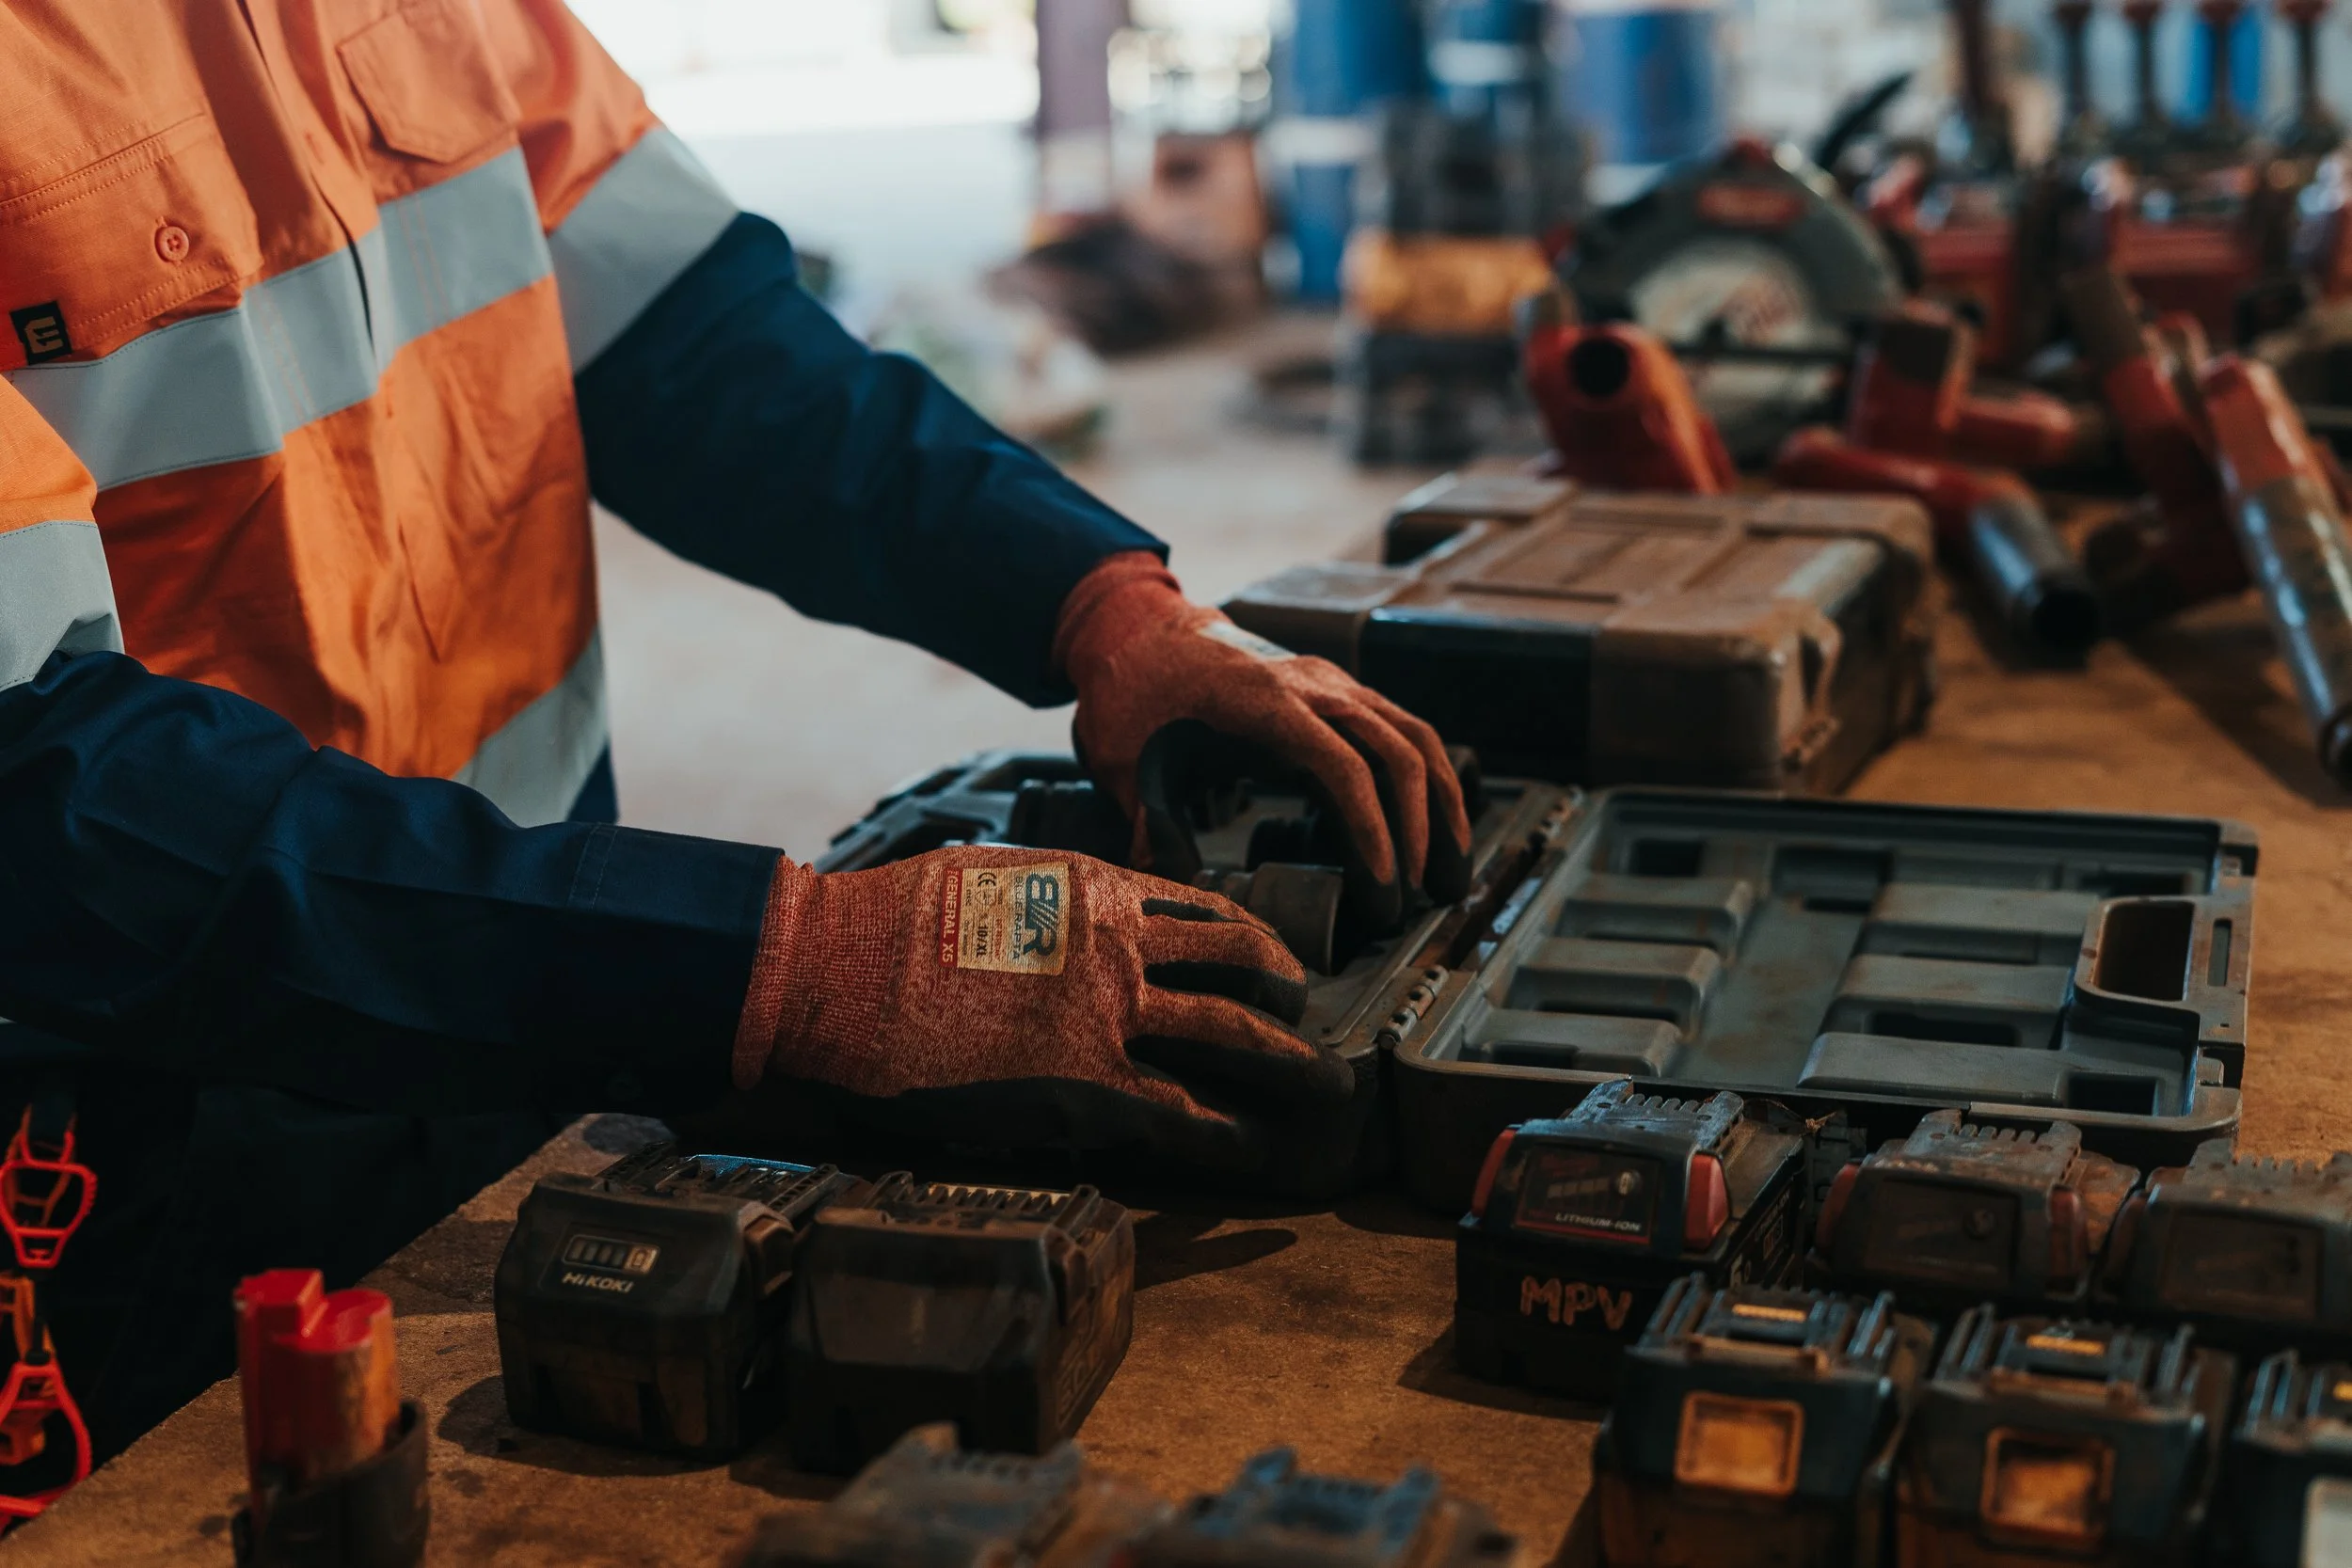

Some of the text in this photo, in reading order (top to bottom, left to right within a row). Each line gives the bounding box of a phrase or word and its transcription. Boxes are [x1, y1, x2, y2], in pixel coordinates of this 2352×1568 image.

[944, 877, 958, 939] GENERAL
[942, 942, 954, 963] X5
[976, 925, 989, 958] 10/XL
[1555, 1212, 1643, 1233] LITHIUM-ION
[1519, 1275, 1634, 1332] MPV
